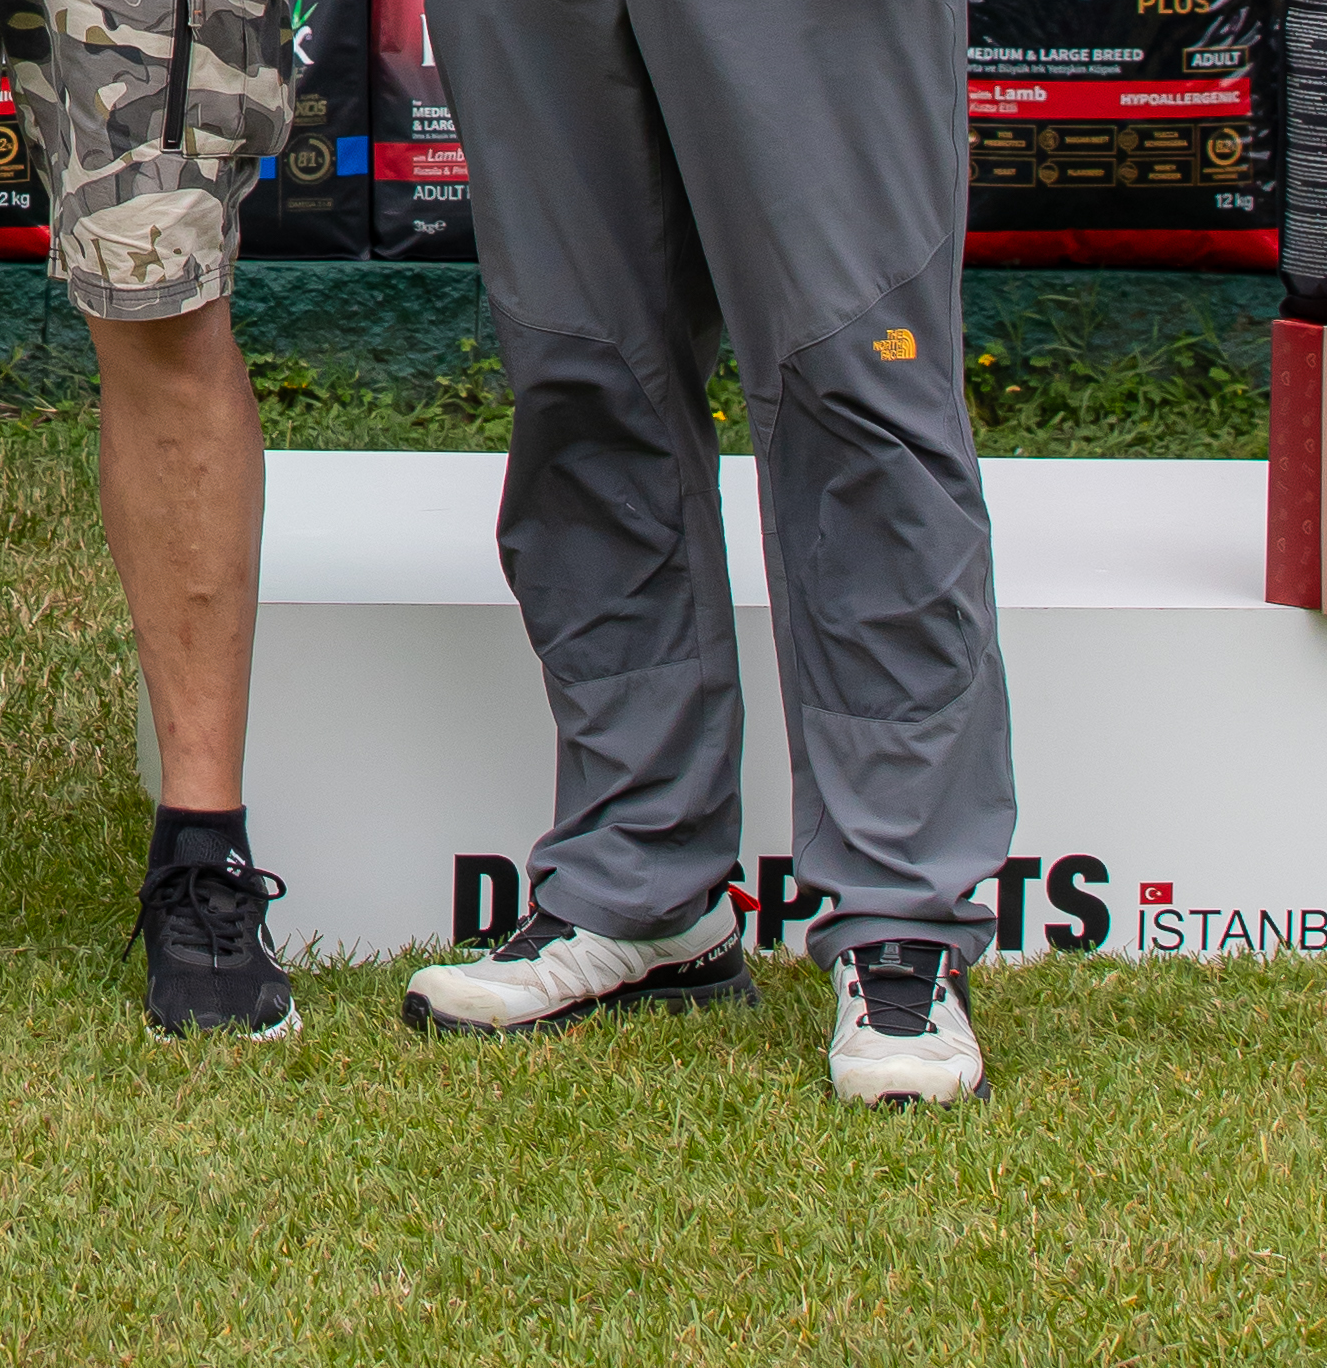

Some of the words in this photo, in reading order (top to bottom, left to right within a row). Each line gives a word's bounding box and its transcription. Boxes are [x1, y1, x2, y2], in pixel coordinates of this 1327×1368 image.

[1026, 50, 1036, 61] &
[1040, 49, 1090, 61] LARGE
[1092, 49, 1144, 61] BREED
[1191, 52, 1242, 67] ADULT
[994, 85, 1047, 101] Lamb
[1120, 91, 1241, 105] HYPOALLERGENIC
[424, 120, 456, 131] LARG
[427, 148, 465, 162] Lamb
[11, 191, 30, 208] kg
[413, 185, 464, 201] ADULT
[1215, 193, 1232, 209] 12
[1234, 193, 1254, 210] kg
[695, 957, 705, 969] X
[708, 932, 738, 962] ULTRA
